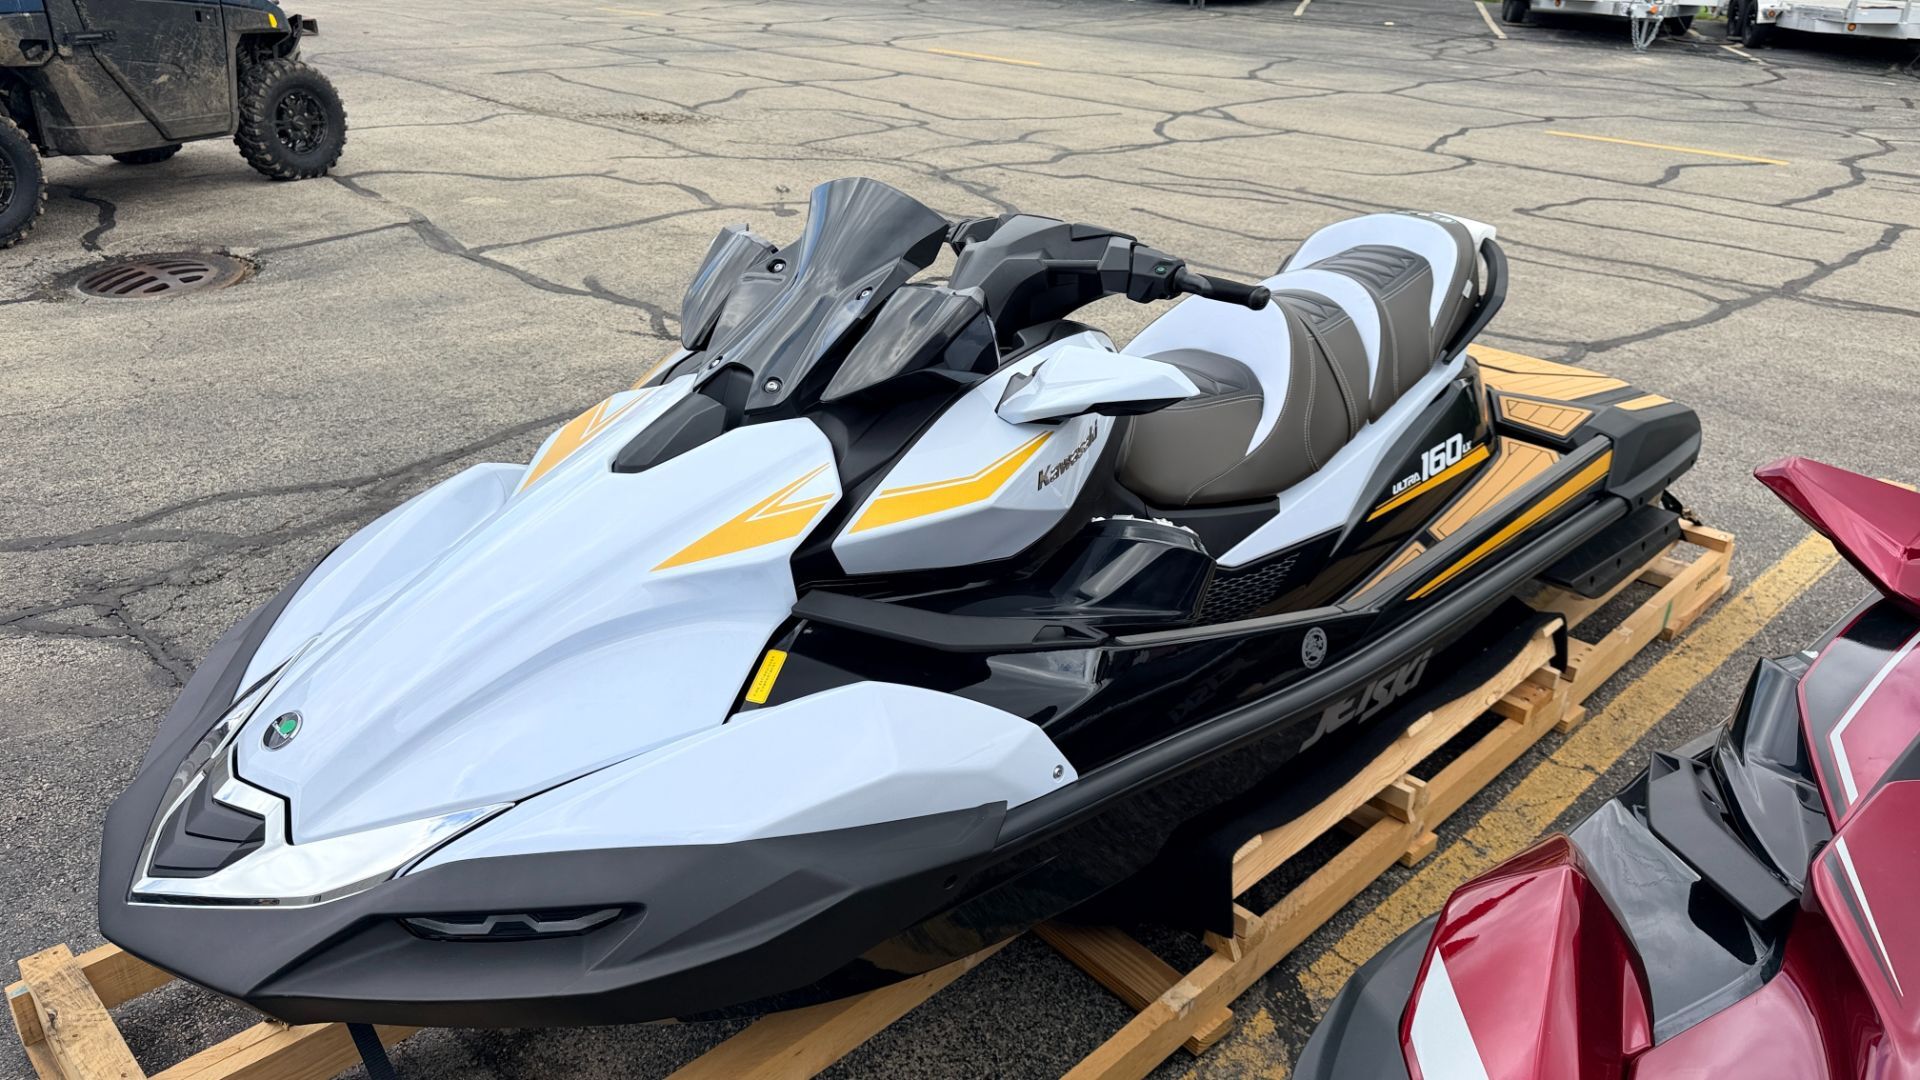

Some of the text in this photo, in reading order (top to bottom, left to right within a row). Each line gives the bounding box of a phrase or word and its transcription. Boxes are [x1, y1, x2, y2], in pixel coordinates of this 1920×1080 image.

[1038, 419, 1098, 491] Kawasaki
[1392, 472, 1421, 495] ULTRA
[1421, 433, 1463, 481] 160
